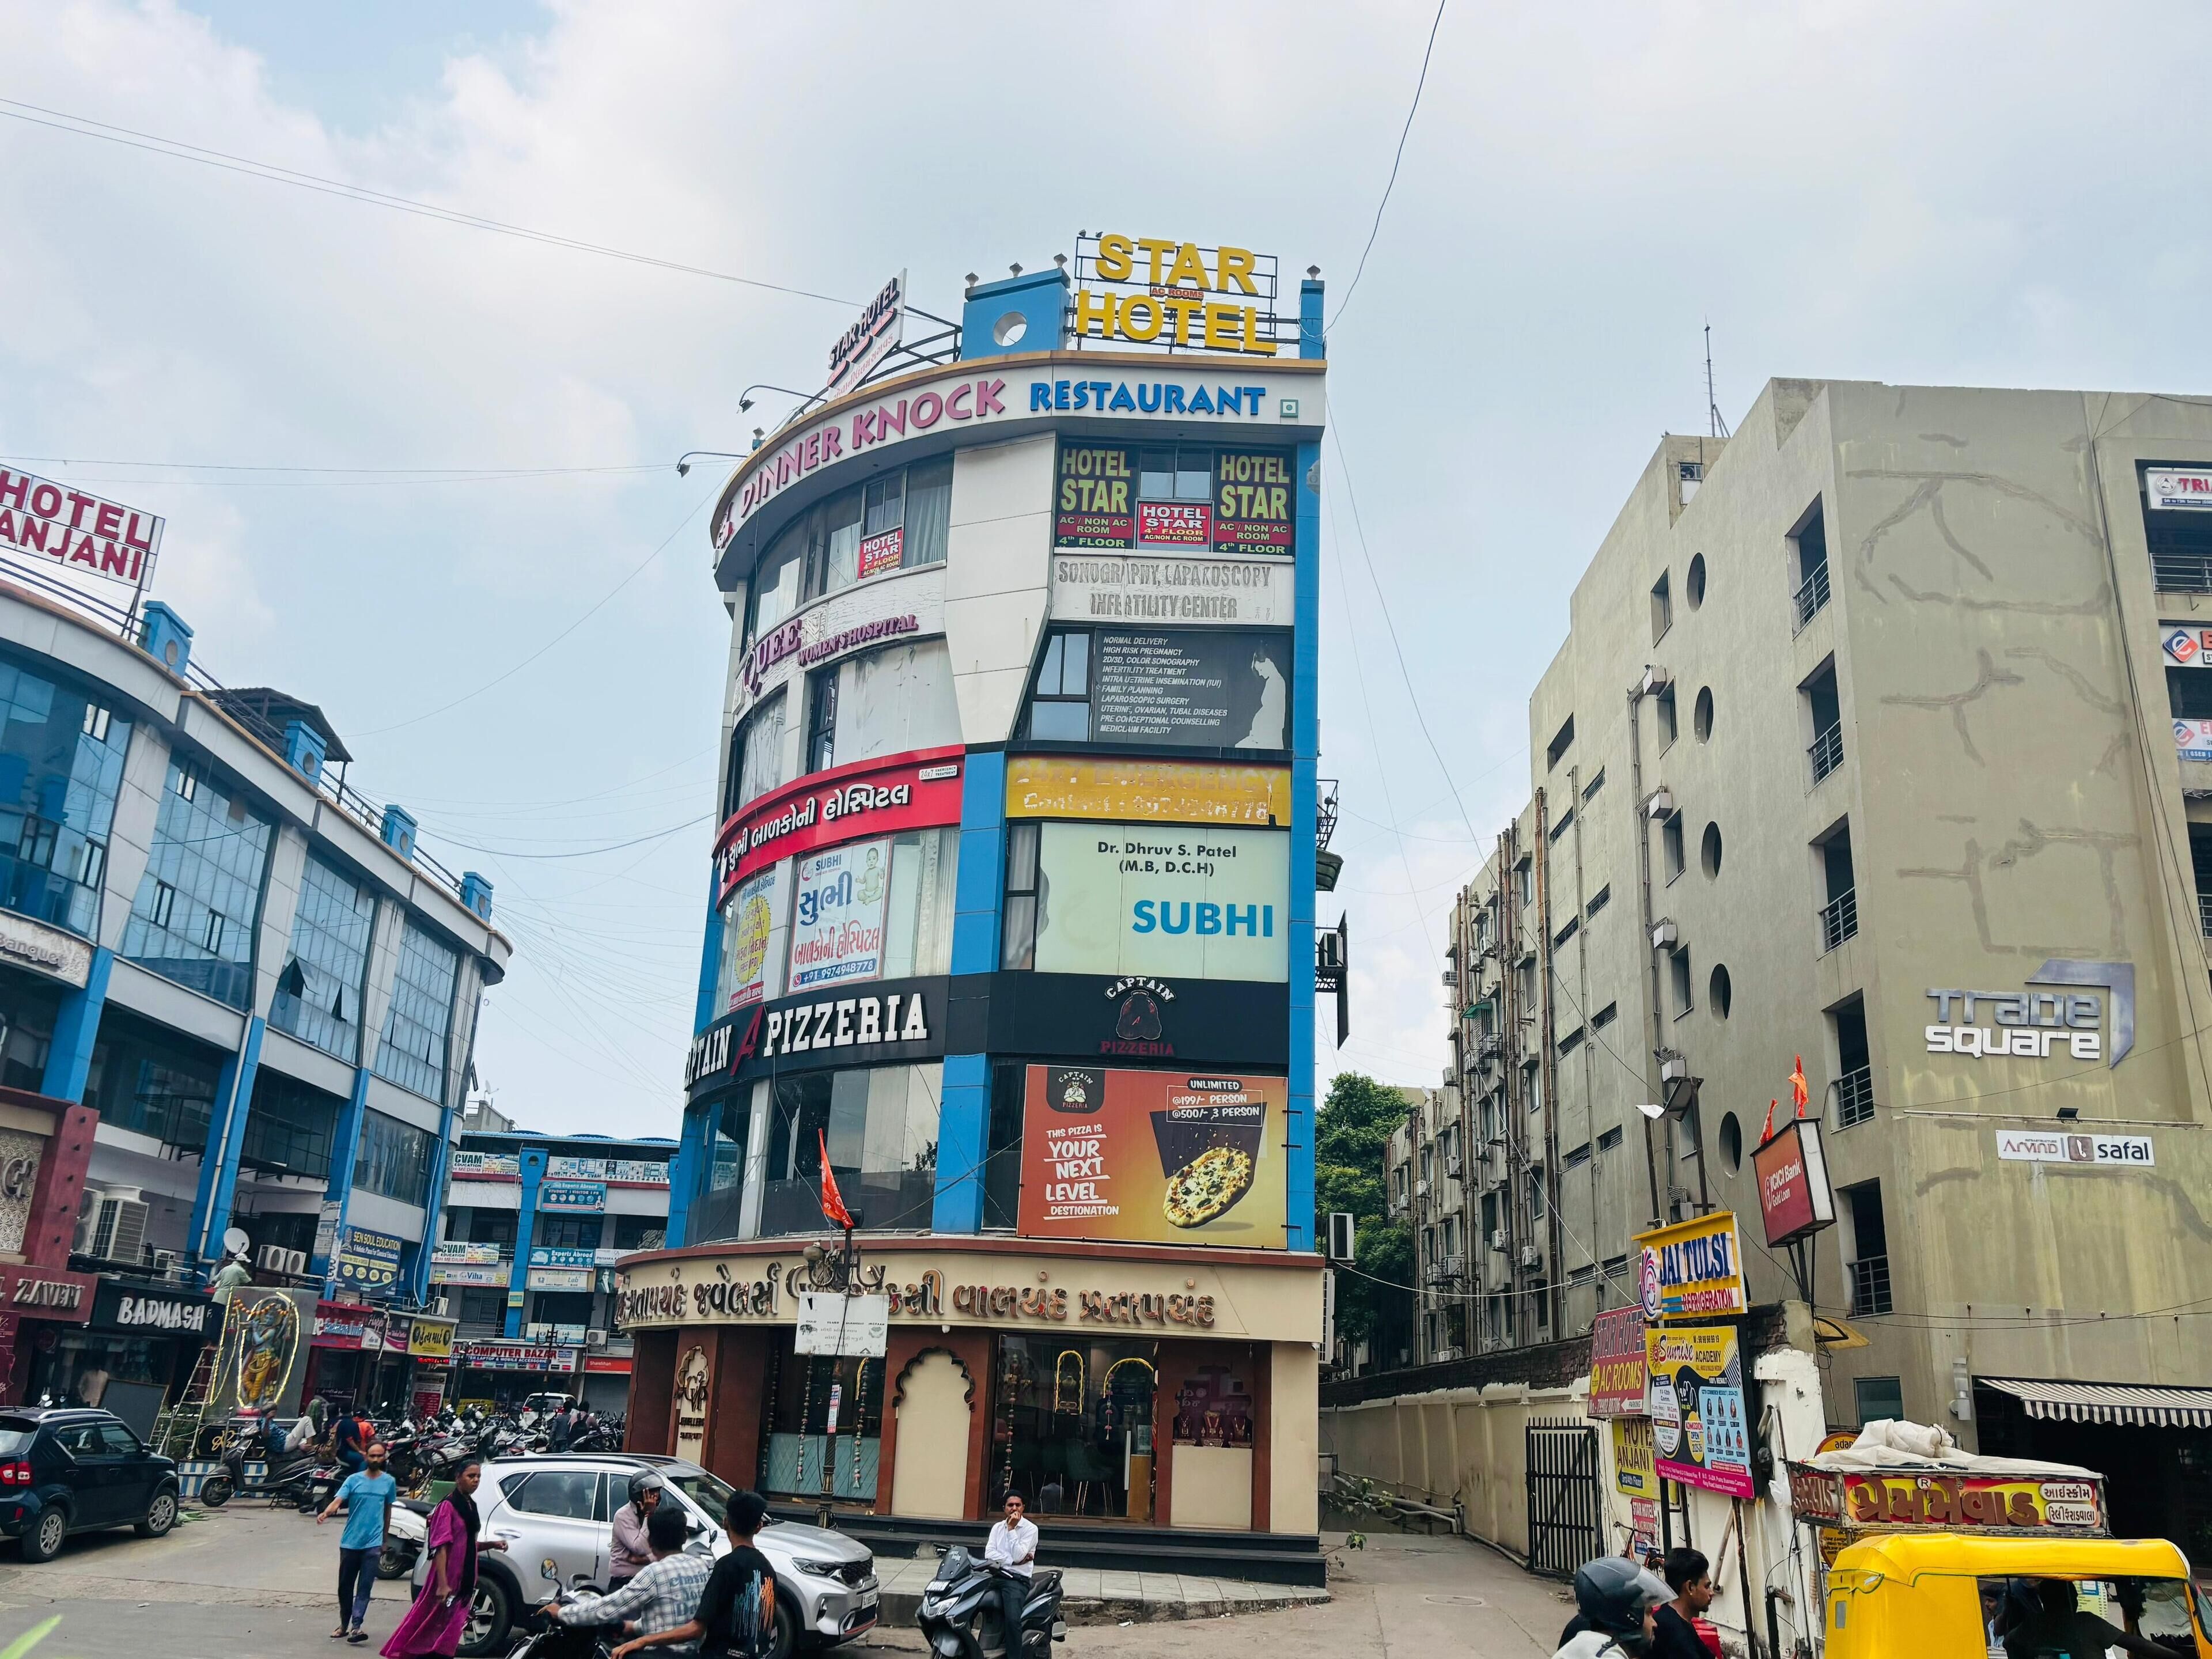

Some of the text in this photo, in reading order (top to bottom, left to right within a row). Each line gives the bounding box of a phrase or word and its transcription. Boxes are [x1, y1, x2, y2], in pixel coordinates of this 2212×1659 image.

[1095, 233, 1258, 294] STAR
[1151, 287, 1204, 299] AC ROOMS
[828, 323, 859, 369] STAR
[860, 277, 900, 337] HOTEL
[1075, 289, 1277, 355] HOTEL
[741, 378, 1266, 518] DINNER KNOCK RESTAURANT
[1062, 448, 1130, 477] HOTEL
[1221, 455, 1289, 484] HOTEL
[1061, 479, 1128, 514] STAR
[1220, 484, 1287, 520] STAR
[0, 469, 149, 551] HOTEL
[1143, 506, 1206, 519] HOTEL
[1060, 517, 1128, 527] AC NON AC
[1077, 525, 1110, 535] ROOM
[1146, 518, 1203, 528] STAR
[1219, 522, 1287, 533] AC NON AC
[0, 509, 142, 581] ANJANI
[863, 533, 900, 555] HOTEL
[1079, 537, 1125, 547] FLOOR
[1237, 532, 1270, 540] ROOM
[865, 544, 899, 563] STAR
[1239, 544, 1285, 554] FLOOR
[874, 554, 899, 567] FLOOR
[797, 614, 919, 667] WOMEN'S HOSPITAL
[1103, 637, 1132, 645] NORMAL
[1140, 648, 1183, 656] PREGNANCY
[1103, 666, 1144, 674] INFERTILITY
[1151, 658, 1200, 666] SONOGRAPHY
[1127, 686, 1164, 694] PLANNING
[1156, 677, 1206, 685] INSEMINATION
[1206, 679, 1221, 688] (IUI)
[1101, 695, 1189, 705] LAPAROSCOPIC SURGERY
[1116, 715, 1170, 724] CONCEPTIONAL
[1171, 717, 1220, 726] COUNSELLING
[1134, 706, 1167, 715] OVARIAN,
[1193, 709, 1228, 717] DISEASES
[1140, 726, 1171, 734] FACILITY
[822, 783, 911, 820] હોસ્પિટલ
[1097, 842, 1237, 858] Dr. Dhruv S. Patel
[816, 854, 842, 871] SUBHI
[1165, 861, 1214, 877] D.C.H)
[800, 871, 853, 926] સુભી
[1132, 900, 1274, 937] SUBHI
[804, 961, 873, 982] +91 9974948778
[1105, 976, 1176, 1002] CAPTAIN
[763, 993, 927, 1058] PIZZERIA
[1100, 1040, 1175, 1056] PIZZERIA
[1058, 1071, 1093, 1084] CAPTAIN
[1190, 1079, 1240, 1090] UNLIMITED
[1210, 1094, 1247, 1104] PERSON
[1222, 1107, 1260, 1117] PERSON
[1046, 1124, 1103, 1139] THIS PIZZA IS
[1048, 1139, 1100, 1158] YOUR
[2097, 1140, 2149, 1161] safal
[455, 1154, 482, 1164] CVAM
[1056, 1157, 1104, 1180] NEXT
[1770, 1158, 1801, 1192] ICICI Bank
[1046, 1182, 1100, 1201] LEVEL
[1772, 1188, 1791, 1207] Gold Loan
[1050, 1205, 1119, 1215] DESTIONATION
[442, 1244, 466, 1253] CVAM
[1660, 1232, 1733, 1286] JAI TULSI
[953, 1271, 1068, 1320] વાલચંદ
[1079, 1277, 1215, 1329] પ્રતાપચંદ
[1681, 1287, 1734, 1312] REFRIGERATION
[117, 1297, 205, 1331] BADMASH
[1594, 1316, 1616, 1359] STAR
[468, 1347, 557, 1359] COMPUTER BAZAR
[1659, 1335, 1694, 1362] Sunrise
[1696, 1351, 1721, 1362] ACADEMY
[1600, 1360, 1642, 1392] AC ROOMS
[1618, 1446, 1650, 1472] ANJANI
